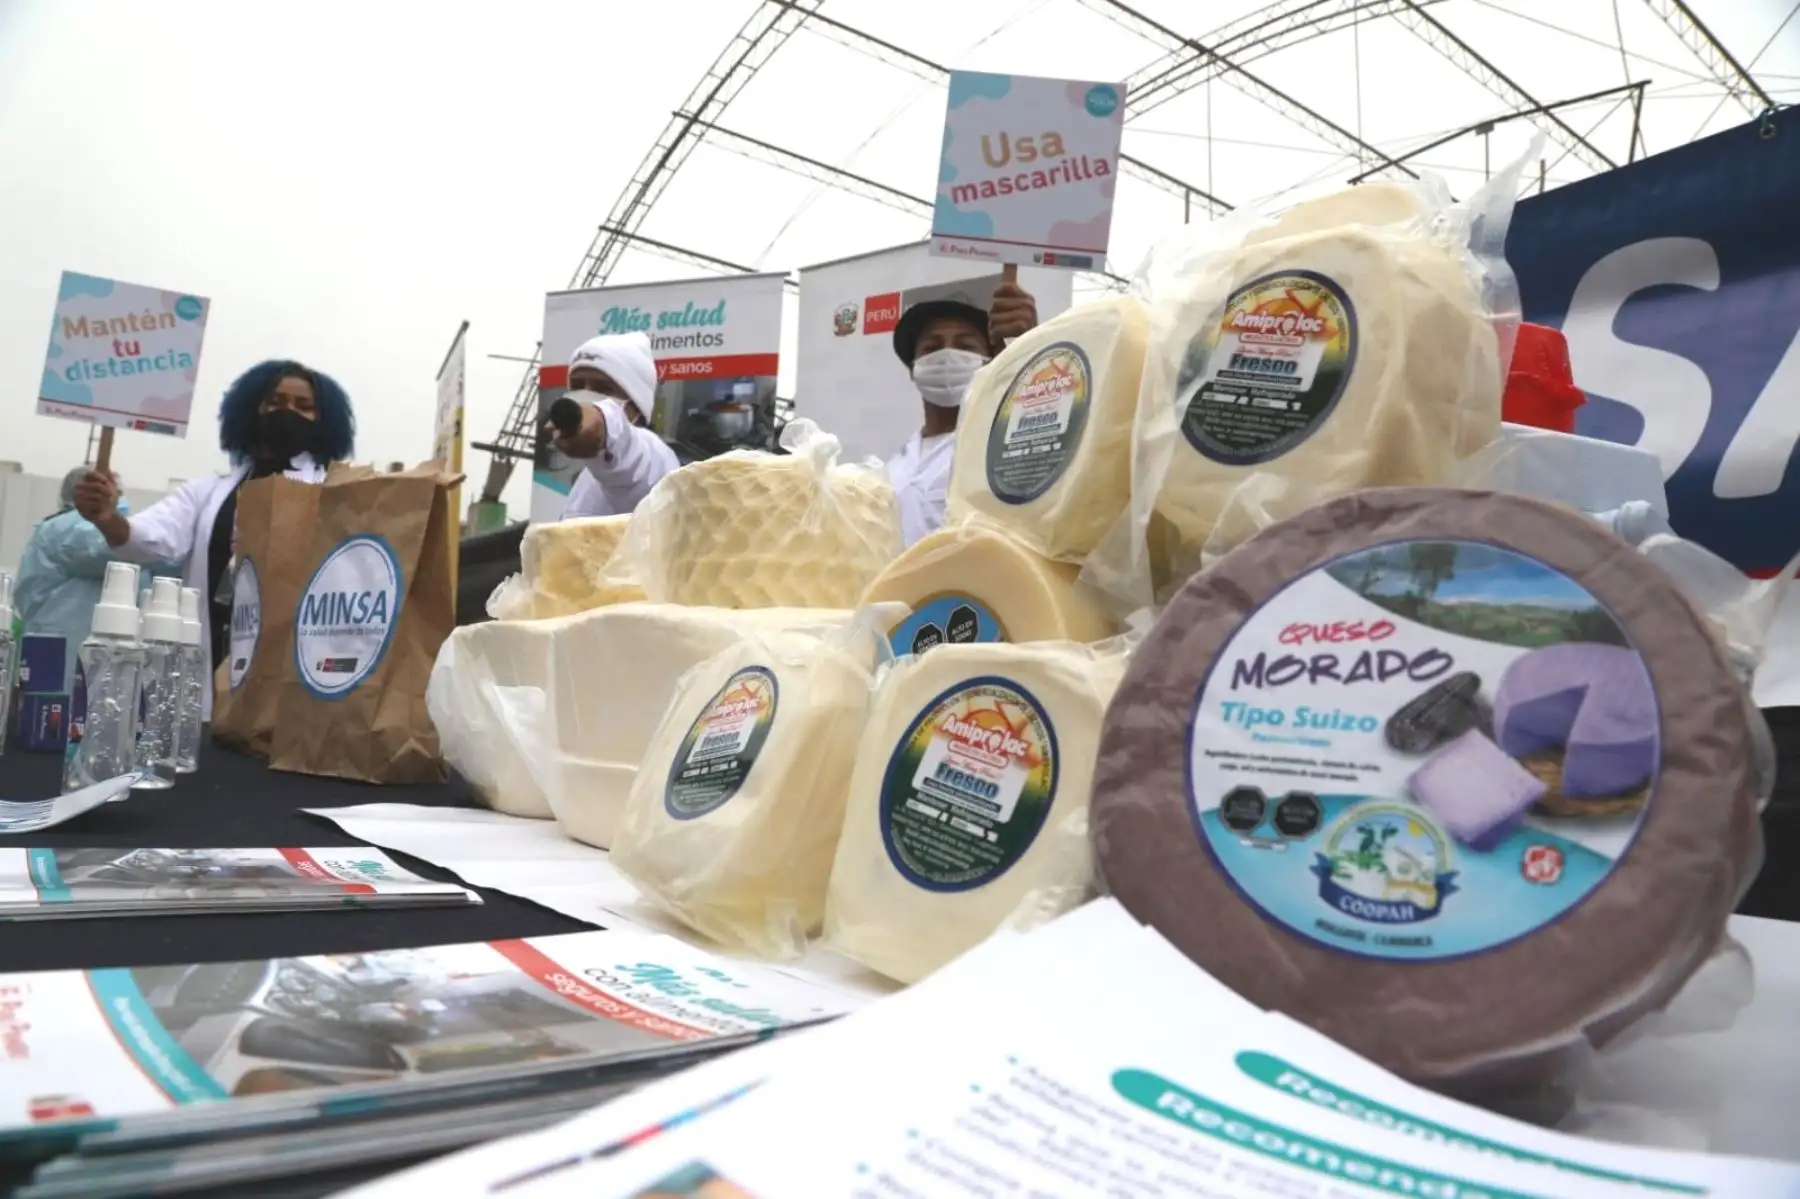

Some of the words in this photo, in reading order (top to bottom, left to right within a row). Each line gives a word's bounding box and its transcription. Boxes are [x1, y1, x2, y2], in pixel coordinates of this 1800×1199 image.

[980, 131, 1065, 169] Usa
[951, 155, 1111, 204] mascarilla
[62, 308, 176, 340] Mantén
[600, 306, 652, 335] Más
[656, 300, 726, 330] salud
[866, 306, 897, 323] PERÚ
[112, 337, 141, 358] tu
[65, 348, 193, 382] distancia
[658, 364, 667, 379] y
[669, 361, 713, 375] sanos
[302, 590, 388, 626] MINSA
[1278, 619, 1396, 645] QUESO
[1230, 647, 1454, 690] MORADO
[1220, 701, 1286, 730] Tipo
[1292, 705, 1379, 734] Suizo
[583, 967, 633, 993] con
